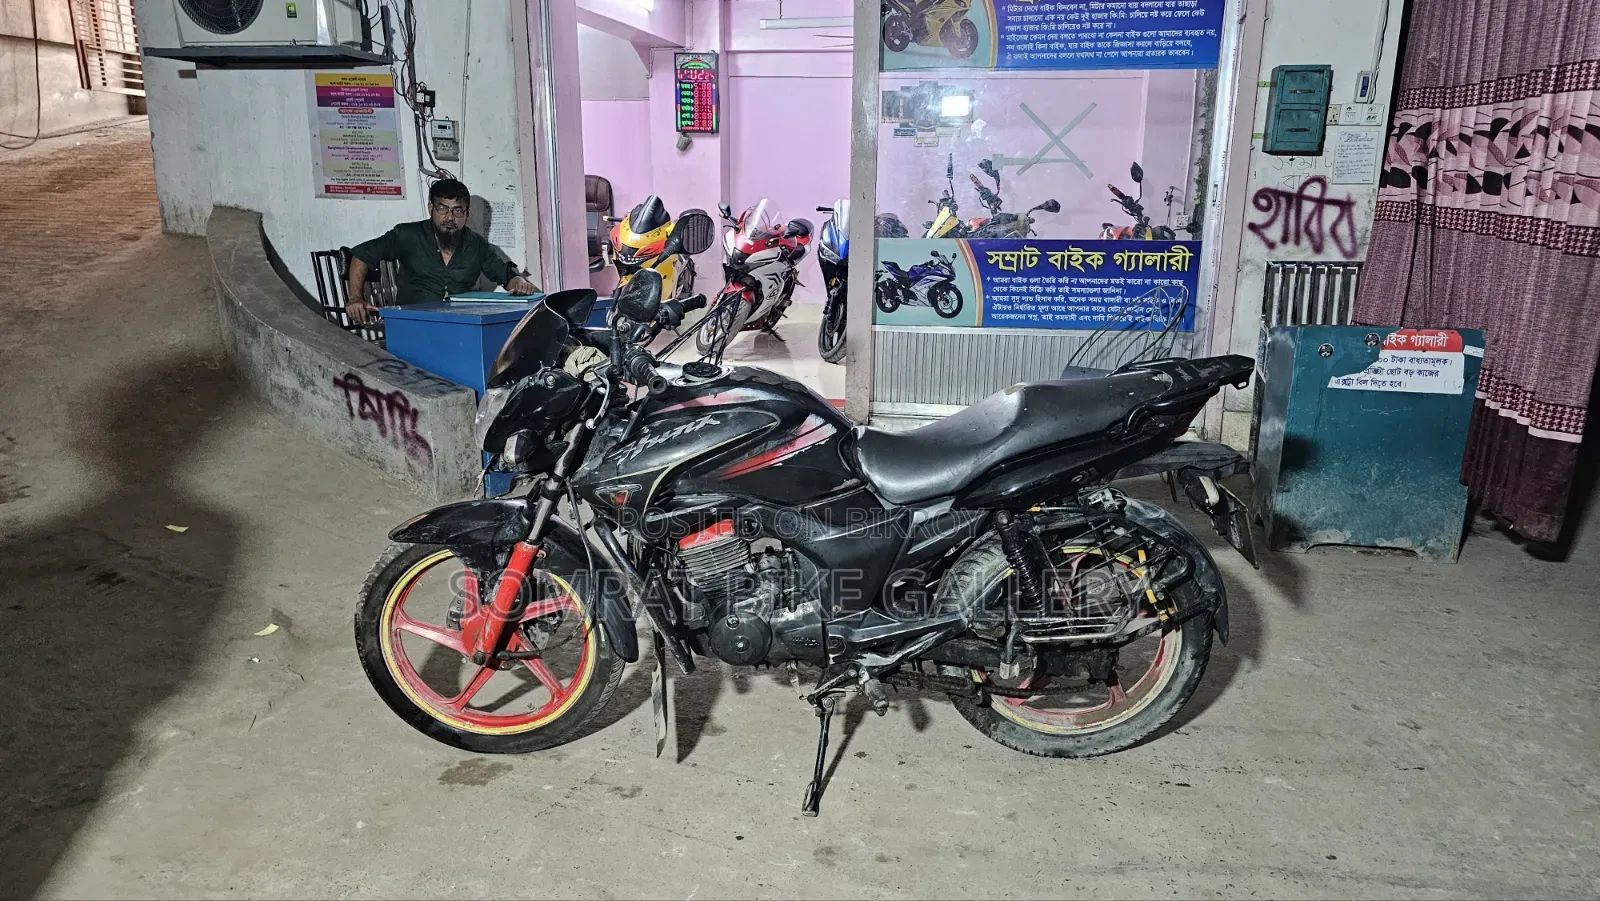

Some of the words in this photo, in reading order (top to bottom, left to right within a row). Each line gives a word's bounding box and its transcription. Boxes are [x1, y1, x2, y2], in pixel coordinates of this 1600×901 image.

[1040, 4, 1055, 12] বাইক
[1125, 30, 1141, 39] বাইক
[1080, 41, 1095, 50] বাইক
[985, 244, 1042, 273] সম্রাট
[1046, 244, 1106, 273] বাইক
[1113, 245, 1194, 272] গ্যালারী
[1012, 276, 1027, 284] বাইক
[1410, 331, 1450, 348] গ্যালারী
[1391, 354, 1407, 364] টাকা
[1386, 366, 1402, 376] ছোট
[1416, 369, 1440, 378] কাজের
[1356, 376, 1369, 387] বিল
[1370, 377, 1387, 389] দিতে
